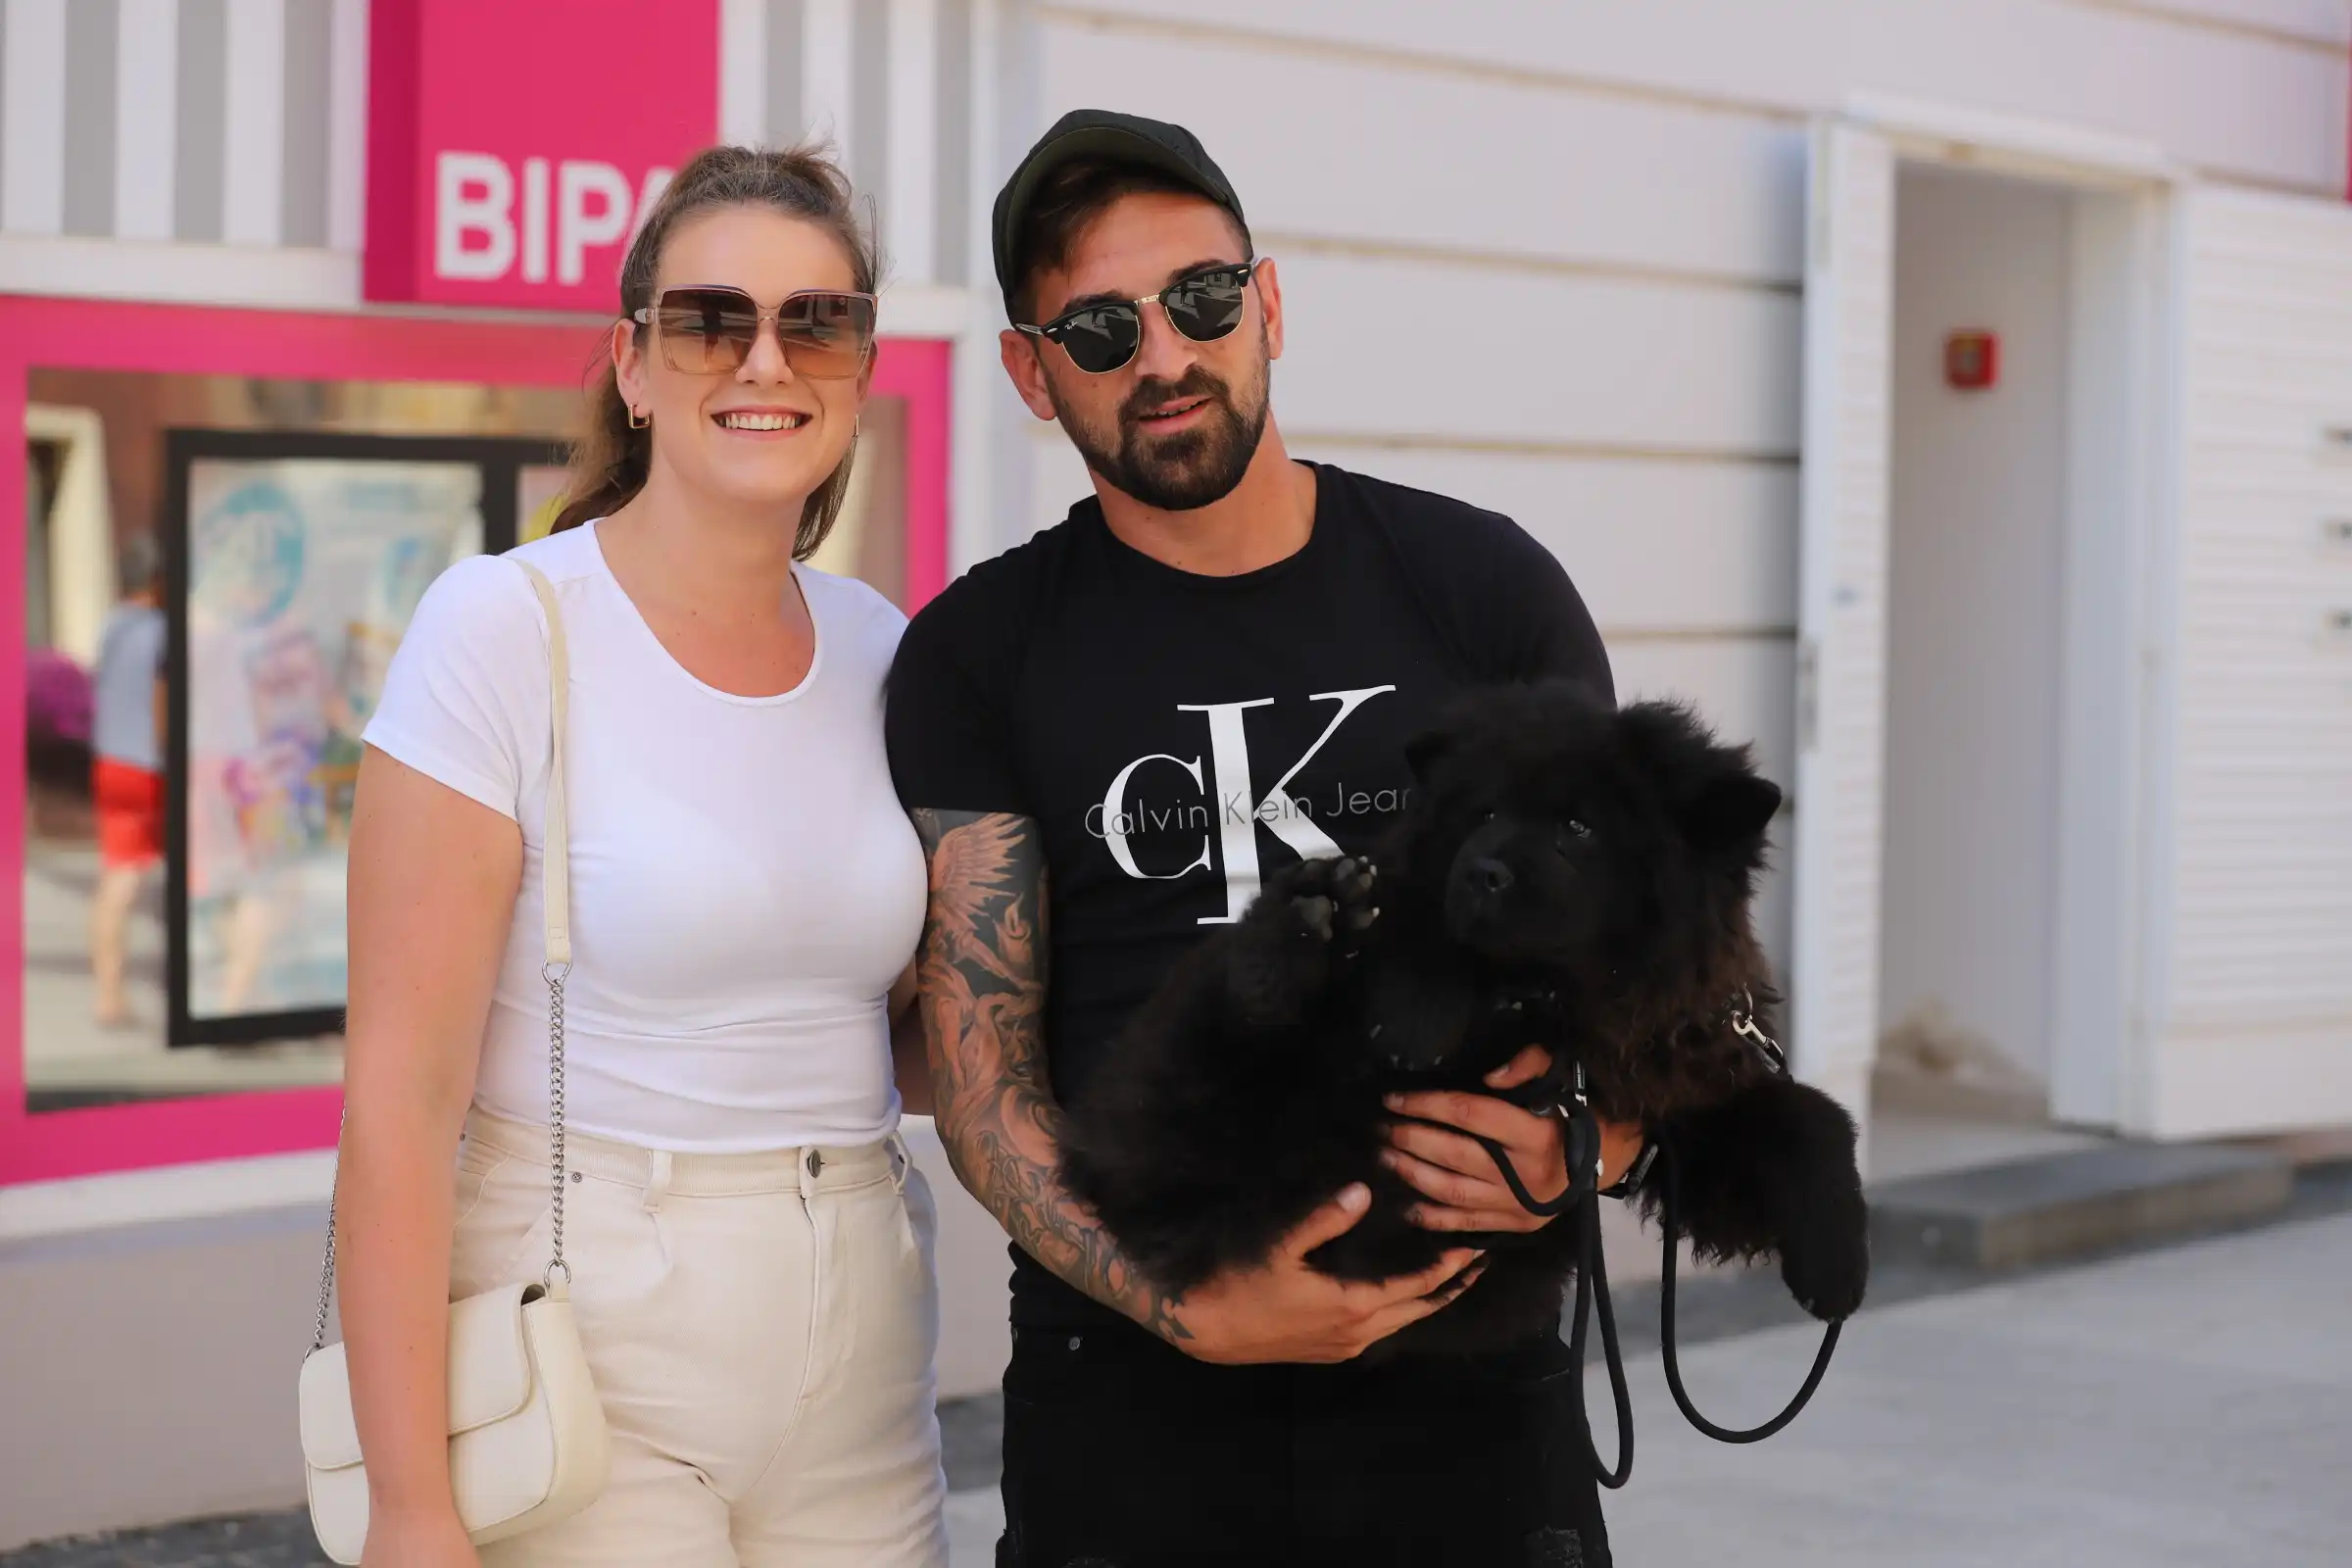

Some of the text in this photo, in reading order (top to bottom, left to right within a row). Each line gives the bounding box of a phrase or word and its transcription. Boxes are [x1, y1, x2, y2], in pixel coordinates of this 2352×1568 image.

[1085, 782, 1411, 839] Calvin Klein Jea
